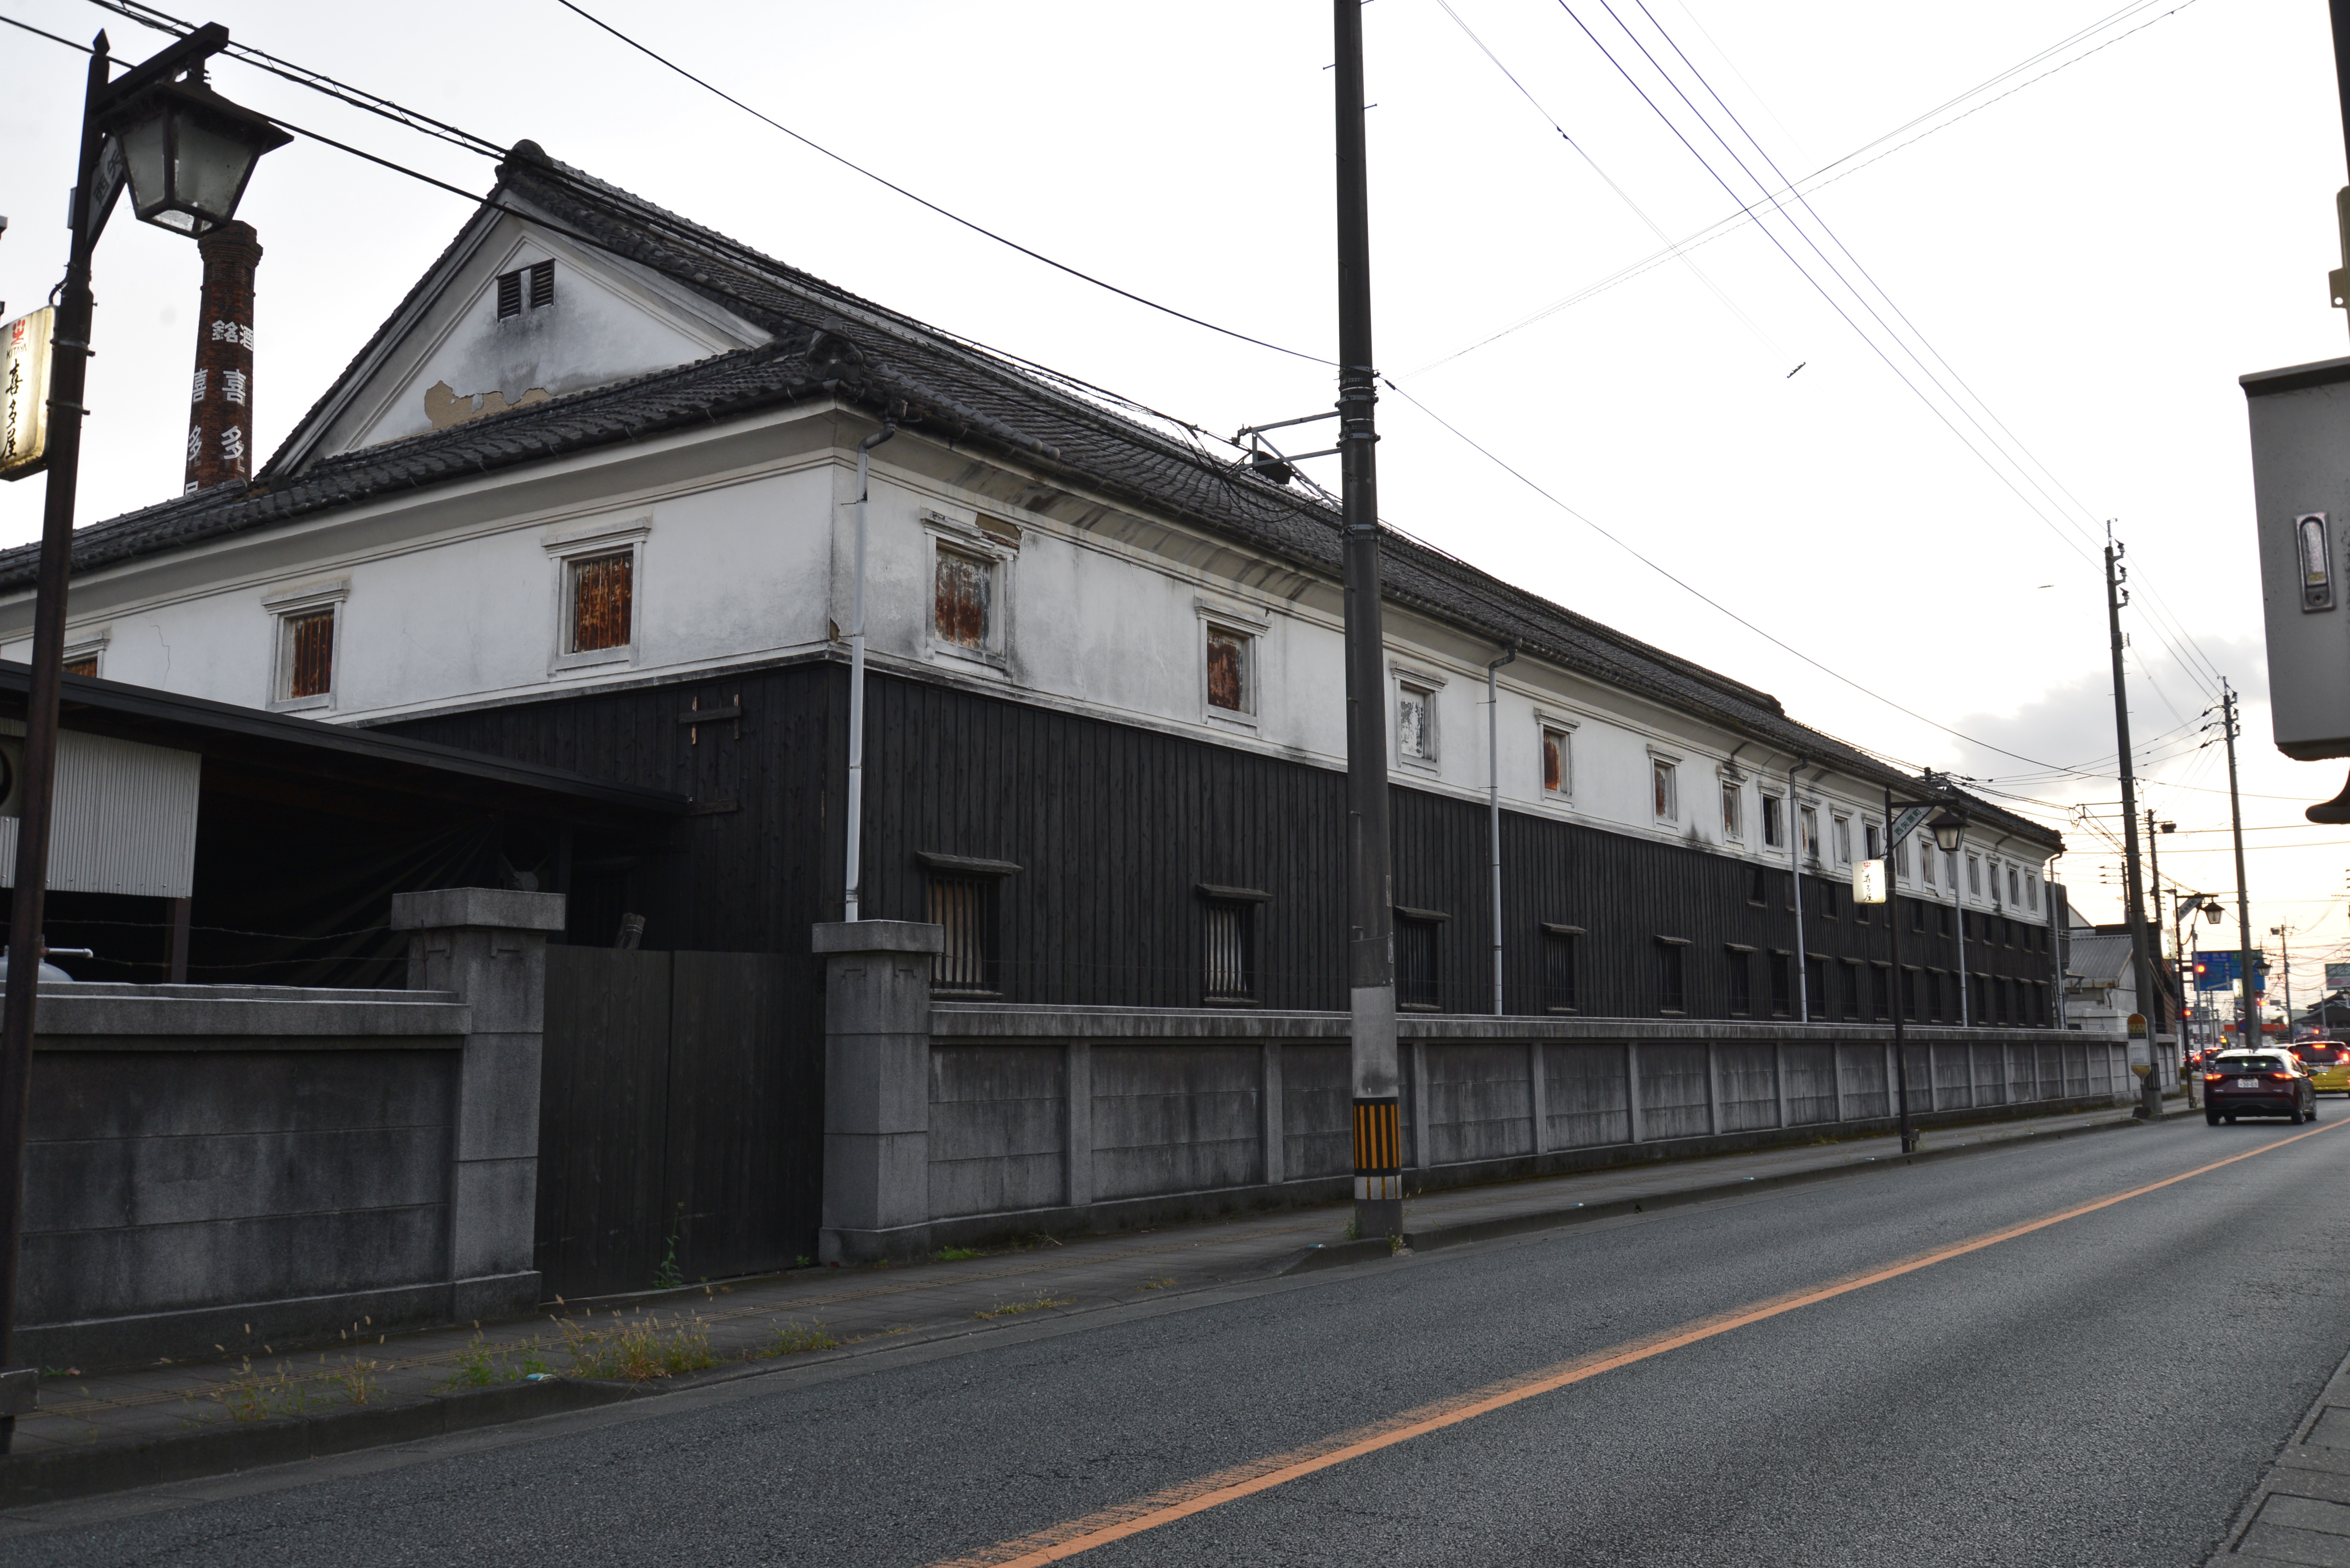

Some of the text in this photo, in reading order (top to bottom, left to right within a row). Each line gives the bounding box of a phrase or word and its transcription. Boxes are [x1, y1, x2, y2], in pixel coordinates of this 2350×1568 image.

[212, 320, 253, 352] 銘酒
[6, 346, 27, 360] KITAYA
[0, 358, 23, 459] 喜多屋
[1894, 808, 1922, 836] 西矢原町
[1863, 873, 1873, 901] 喜多屋
